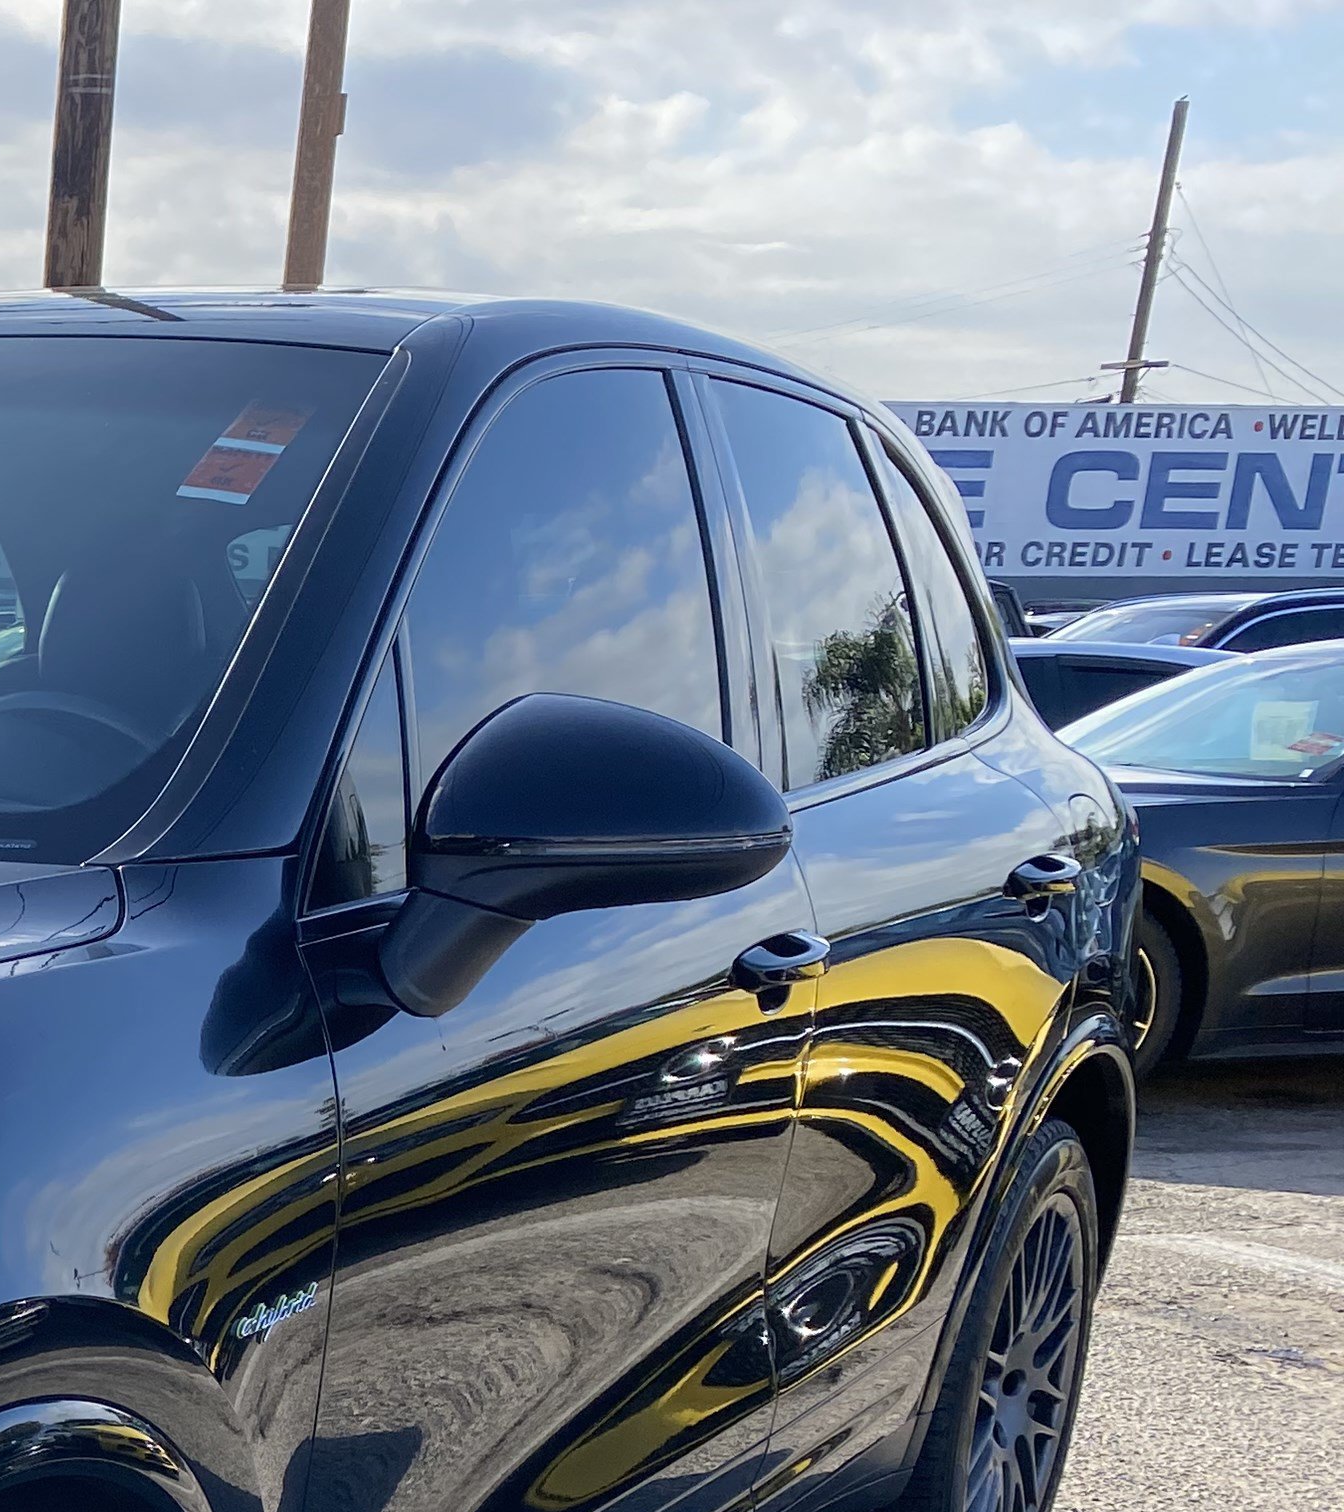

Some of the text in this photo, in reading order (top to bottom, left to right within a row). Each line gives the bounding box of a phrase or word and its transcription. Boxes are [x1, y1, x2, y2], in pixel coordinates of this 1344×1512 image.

[915, 410, 1012, 437] BANK
[1024, 411, 1069, 438] OF
[1075, 411, 1233, 439] AMERICA
[1046, 450, 1344, 530] CEN
[1021, 541, 1152, 568] CREDIT
[1186, 542, 1298, 569] LEASE
